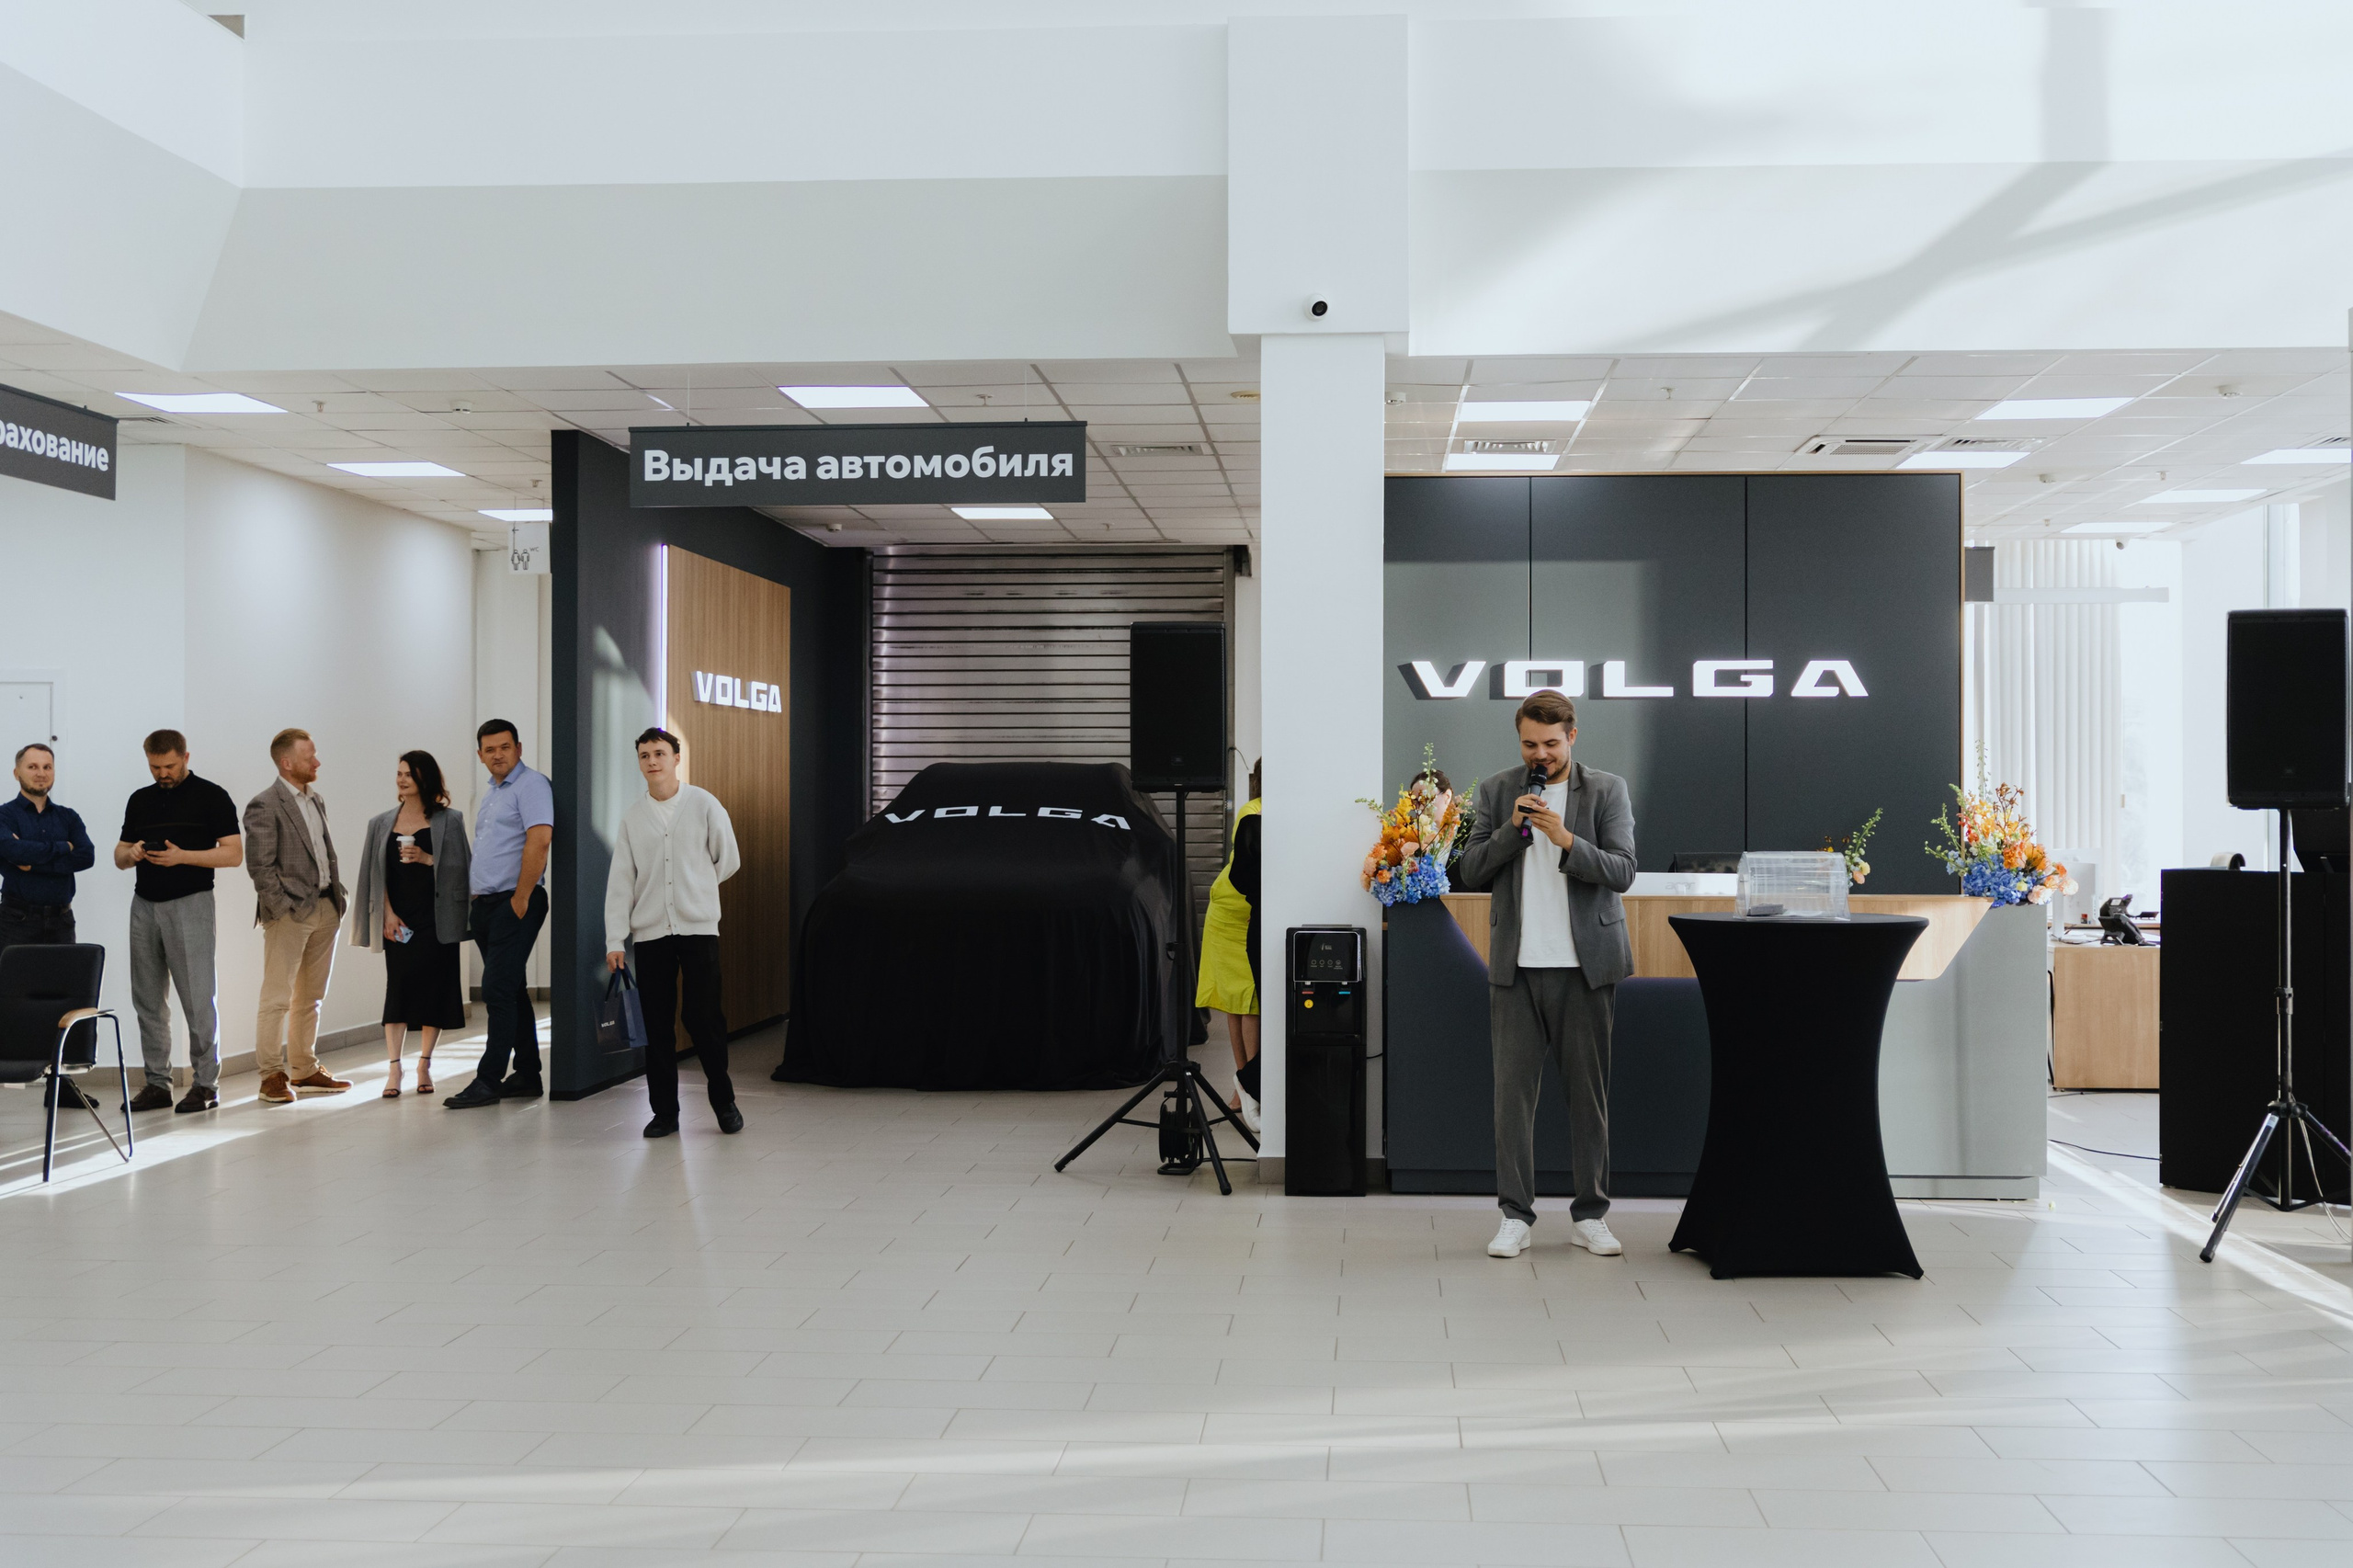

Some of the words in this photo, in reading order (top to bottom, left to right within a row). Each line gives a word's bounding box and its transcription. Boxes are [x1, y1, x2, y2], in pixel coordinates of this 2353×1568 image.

[643, 449, 807, 487] Выдача
[816, 445, 1074, 481] автомобиля
[694, 670, 782, 713] VOLGA
[1412, 660, 1870, 698] VOLGA
[884, 805, 1131, 830] VOLGA
